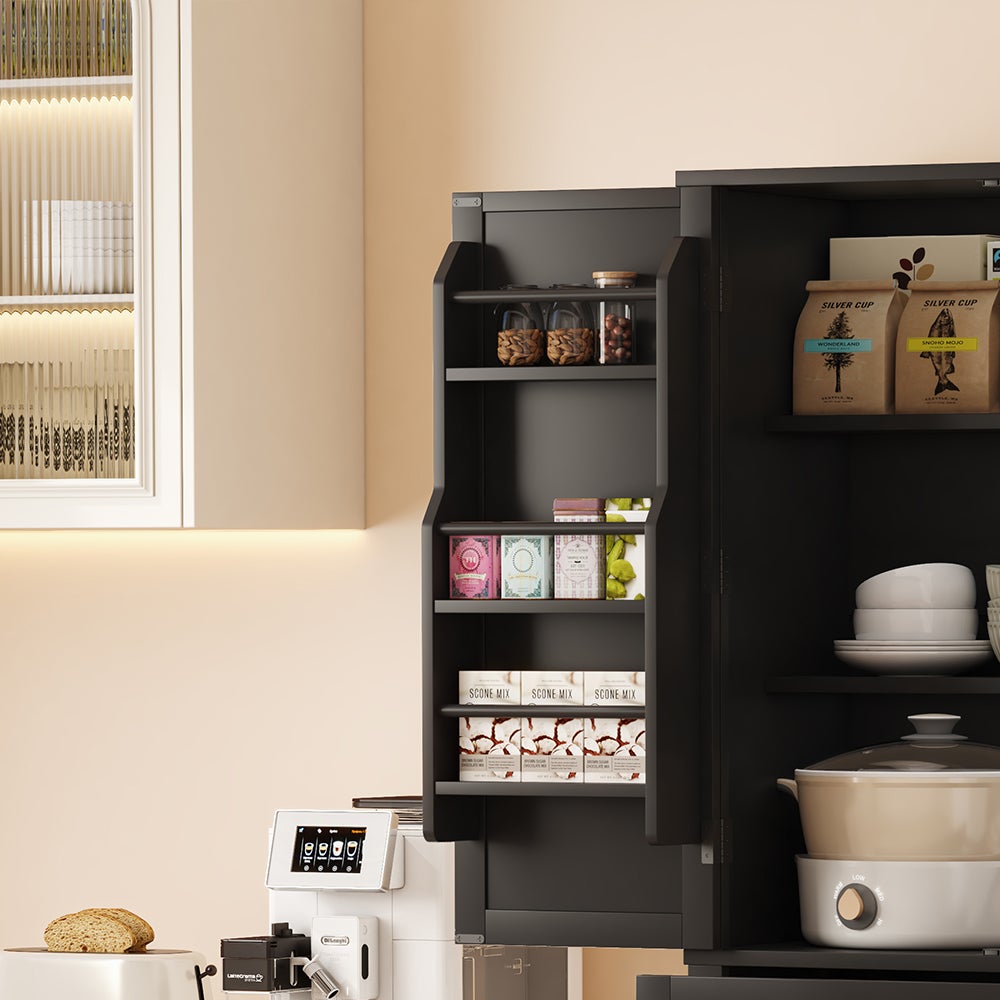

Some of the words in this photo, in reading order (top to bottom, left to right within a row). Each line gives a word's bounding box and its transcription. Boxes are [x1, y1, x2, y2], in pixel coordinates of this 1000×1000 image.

[822, 302, 852, 310] SILVER
[855, 301, 875, 309] CUP
[958, 299, 978, 307] CUP
[469, 688, 493, 699] SCONE
[496, 688, 510, 700] MIX
[532, 689, 556, 699] SCONE
[559, 689, 573, 700] MIX
[595, 689, 619, 699] SCONE
[622, 689, 636, 700] MIX
